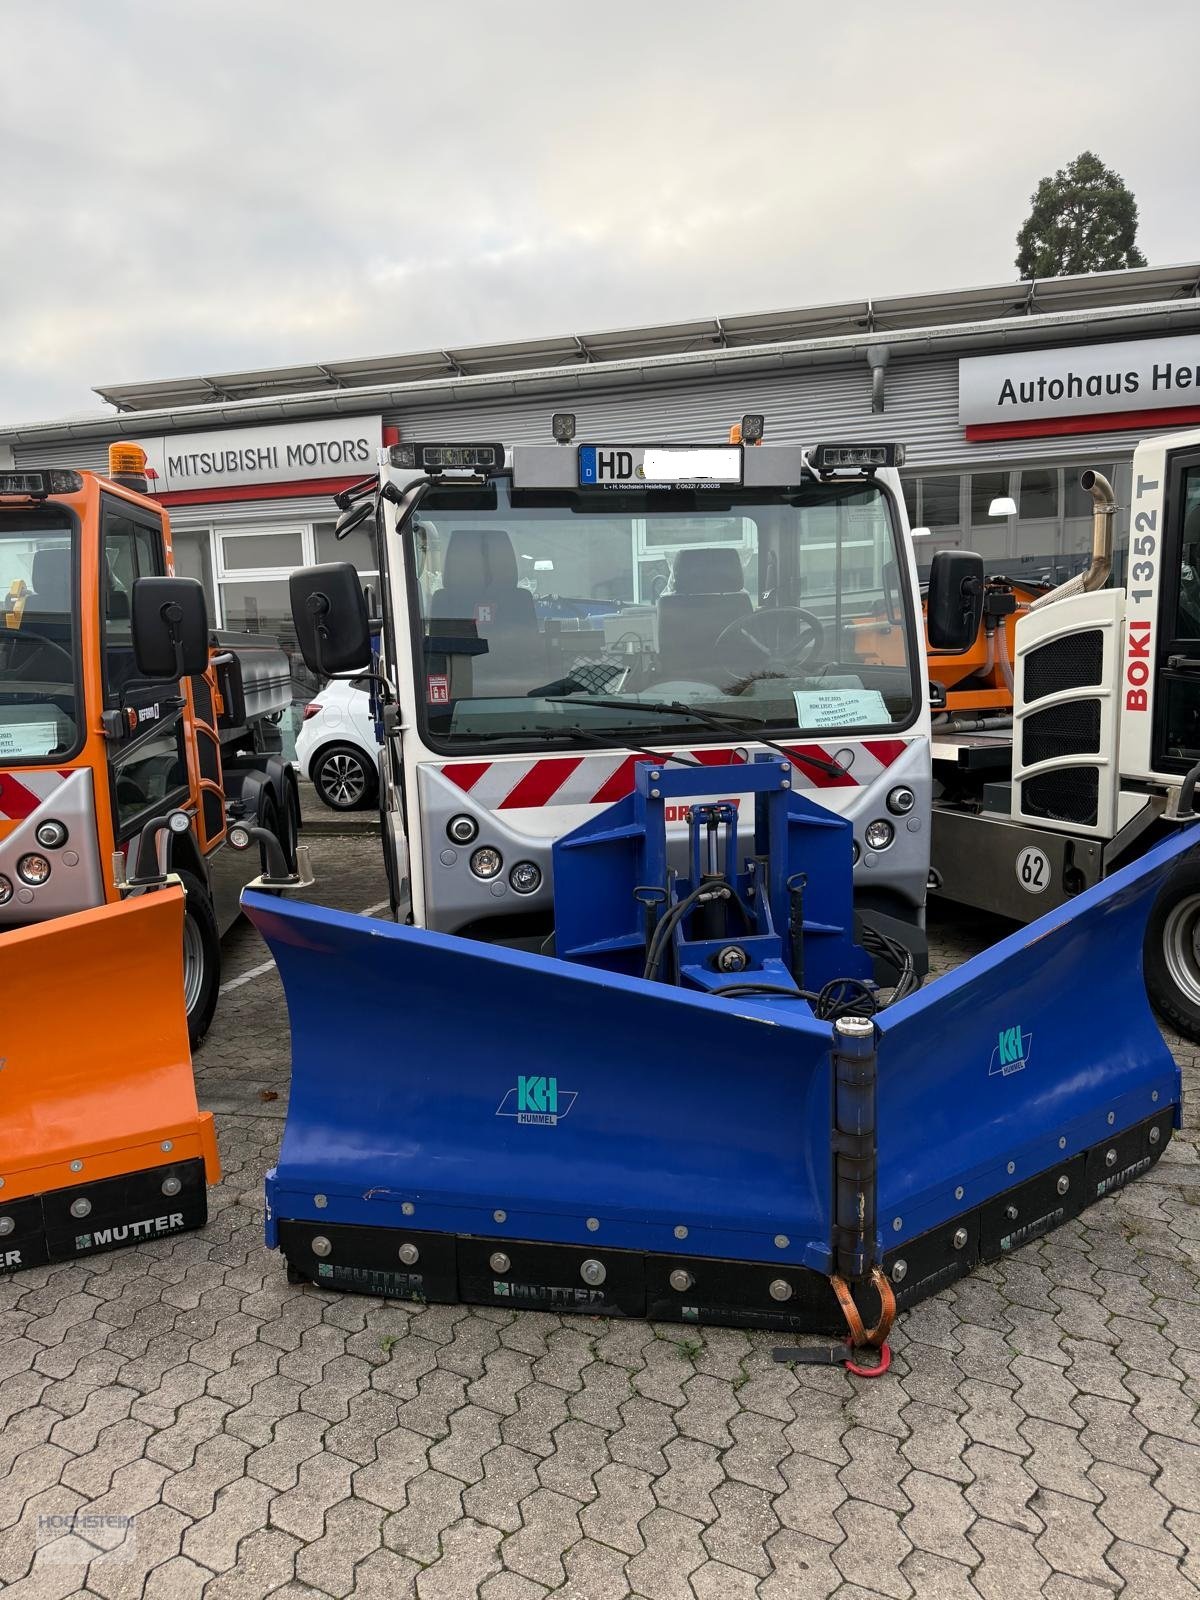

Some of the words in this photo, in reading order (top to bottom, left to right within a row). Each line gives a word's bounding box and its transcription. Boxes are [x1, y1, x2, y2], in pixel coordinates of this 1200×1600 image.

[998, 372, 1139, 405] Autohaus
[168, 446, 279, 477] MITSUBISHI
[286, 438, 370, 467] MOTORS
[586, 468, 592, 476] D
[598, 451, 632, 479] HD
[1137, 474, 1159, 499] T
[1131, 510, 1157, 604] 1352
[1126, 621, 1151, 711] BOKI
[1022, 854, 1043, 886] 62
[520, 1114, 555, 1124] HUMMEL
[93, 1212, 185, 1246] MUTTER
